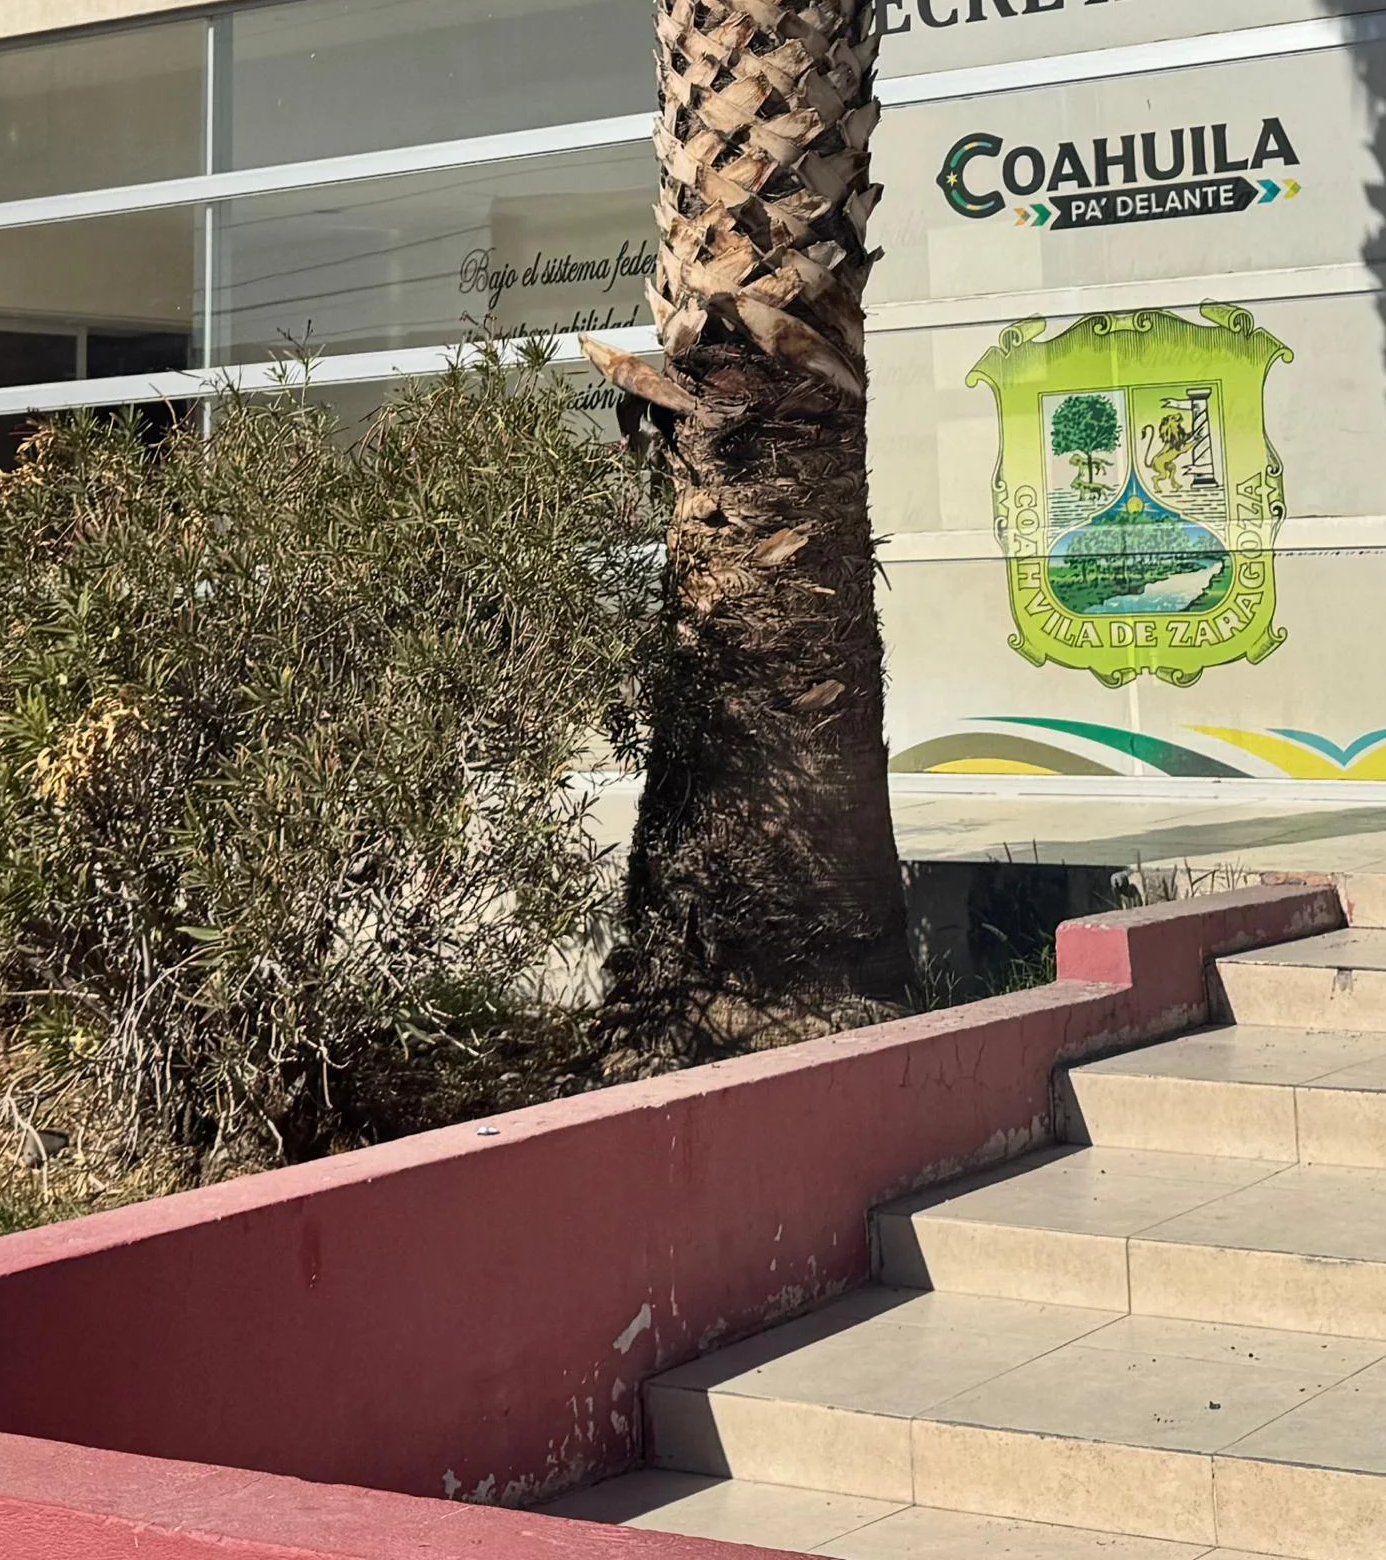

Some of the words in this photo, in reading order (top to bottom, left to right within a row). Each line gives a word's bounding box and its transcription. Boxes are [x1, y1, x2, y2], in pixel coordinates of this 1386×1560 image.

[936, 117, 1300, 219] COAHUILA
[1116, 184, 1235, 218] DELANTE
[459, 247, 518, 310] Bajo
[522, 252, 543, 286] el
[541, 253, 610, 285] sistema
[603, 240, 658, 293] feder
[1109, 620, 1158, 648] DE
[1166, 471, 1264, 649] ZARAGOZA
